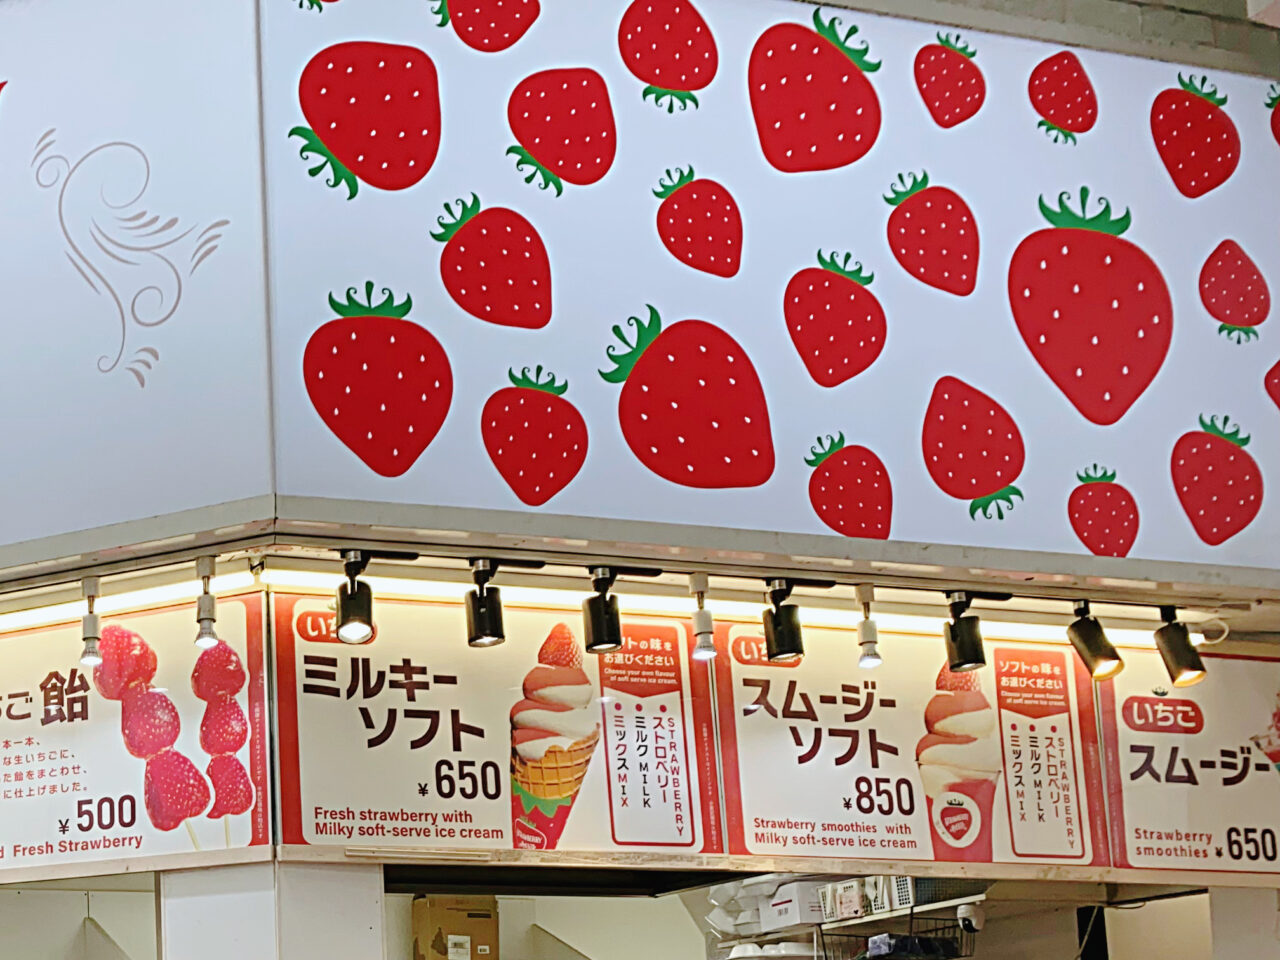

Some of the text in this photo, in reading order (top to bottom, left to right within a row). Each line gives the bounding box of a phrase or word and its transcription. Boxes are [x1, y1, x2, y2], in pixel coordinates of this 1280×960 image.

[303, 655, 458, 702] ミルキー
[743, 678, 897, 723] スムージー
[1133, 702, 1197, 728] いちご
[358, 707, 485, 752] ソフト
[789, 726, 899, 769] ソフト
[667, 717, 683, 837] STRAWBERRY
[1130, 744, 1270, 787] スムージー
[314, 806, 473, 826] Fresh strawberry with
[754, 817, 912, 835] Strawberry smoothies with
[315, 822, 504, 839] Milky soft-serve ice cream
[755, 832, 917, 849] Milky soft-serve ice cream
[1134, 828, 1213, 844] Strawberry
[12, 834, 143, 858] Fresh Strawberry
[1136, 845, 1209, 858] smoothies
